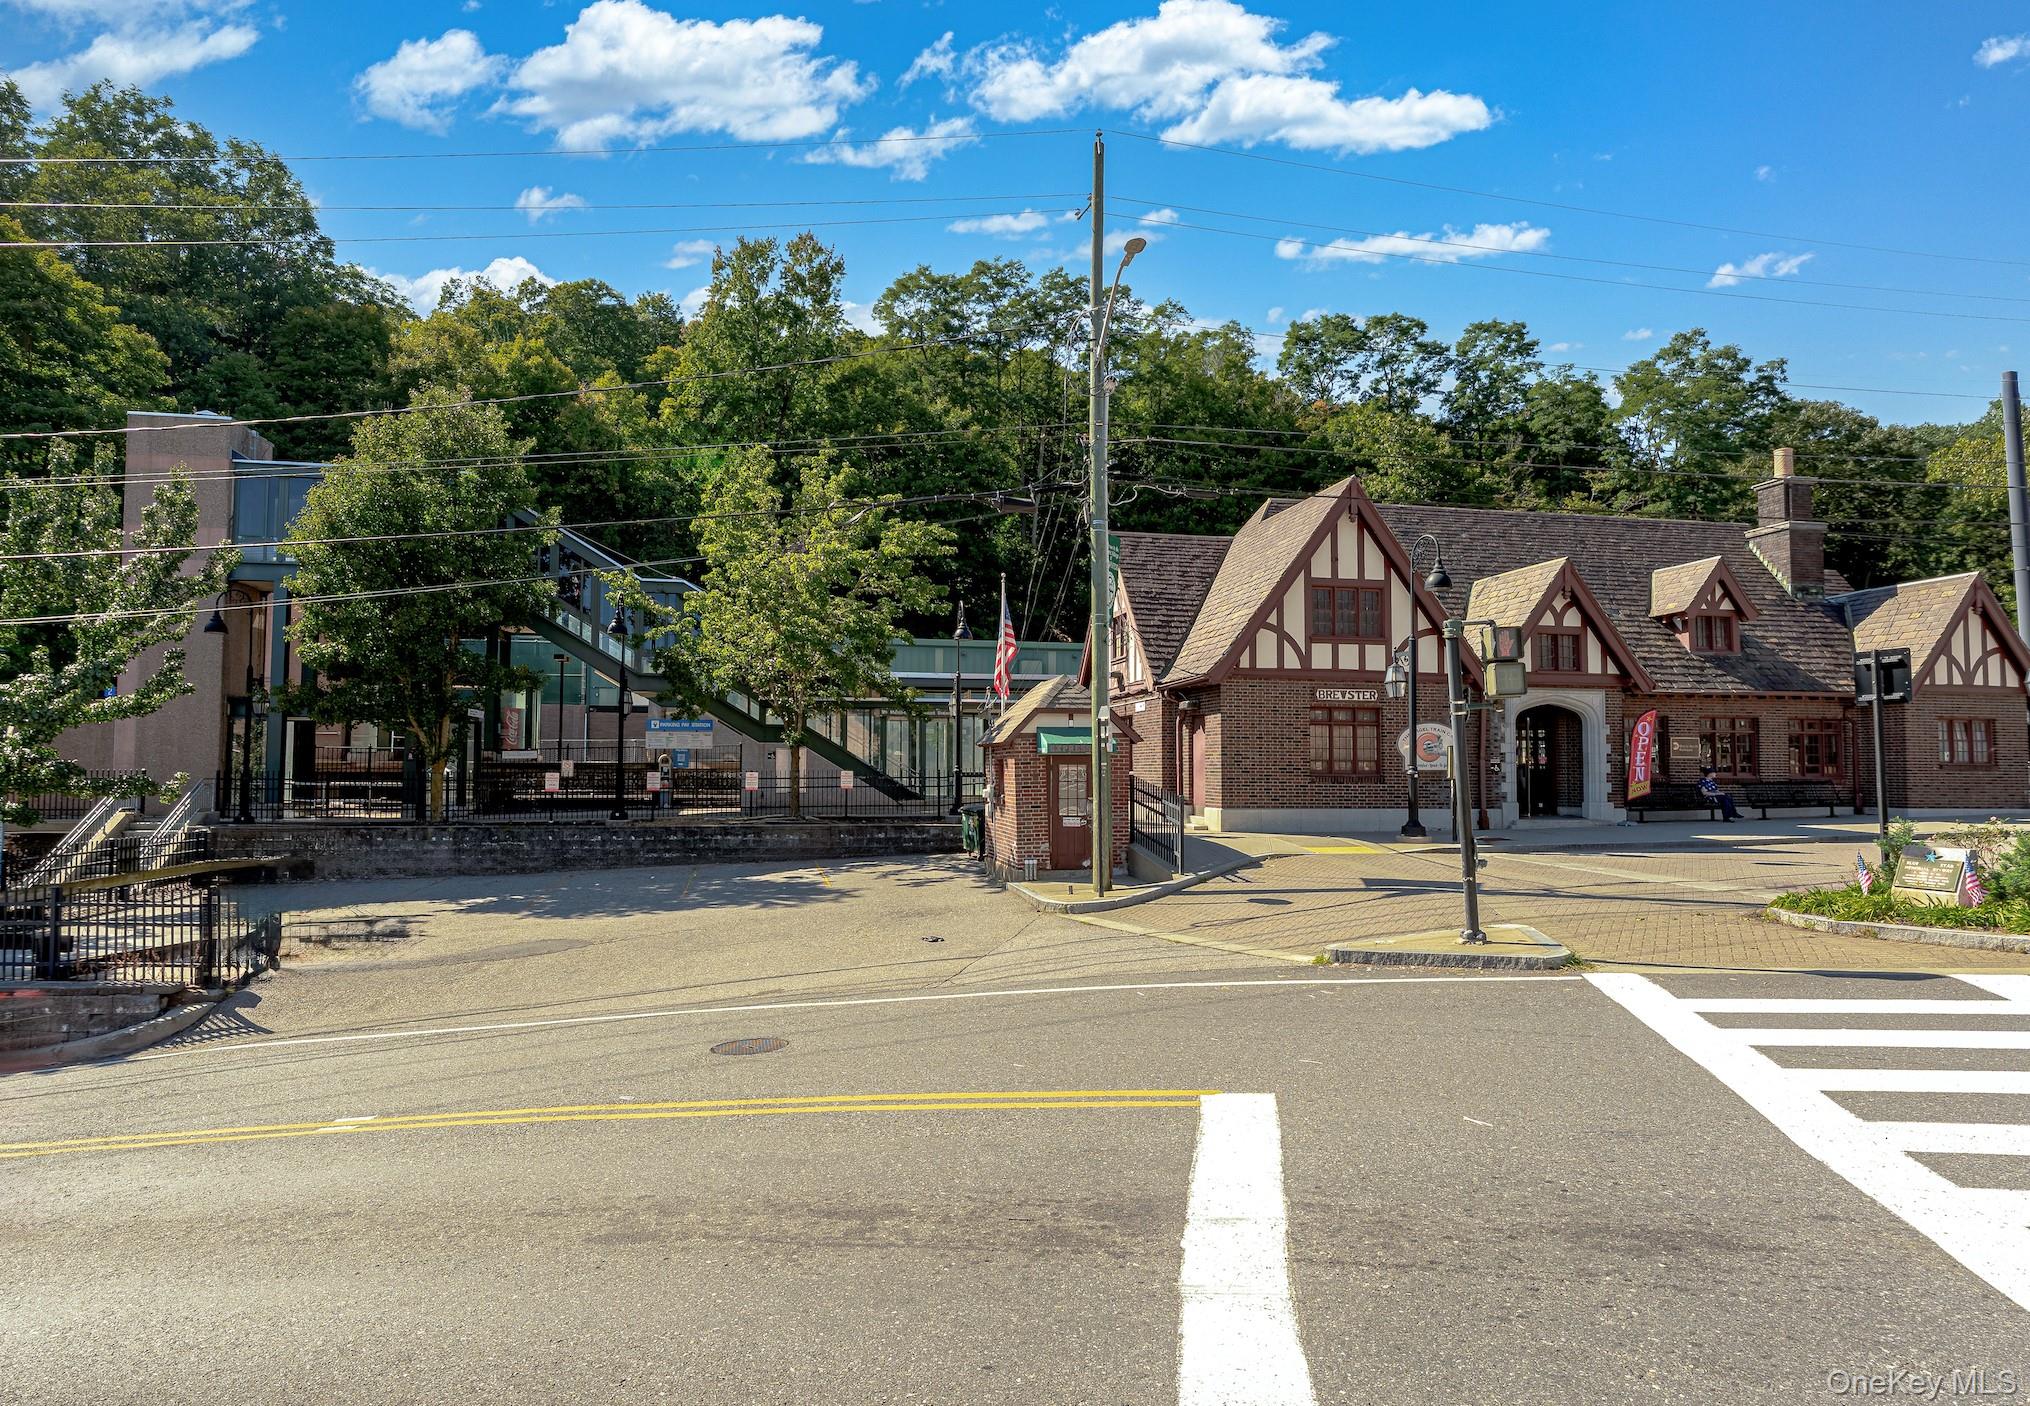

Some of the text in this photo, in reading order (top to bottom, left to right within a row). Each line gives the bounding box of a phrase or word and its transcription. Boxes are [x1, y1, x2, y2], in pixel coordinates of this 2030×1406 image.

[1318, 689, 1376, 700] BREWSTER
[1634, 721, 1650, 781] OPEN
[1631, 784, 1648, 793] NOW
